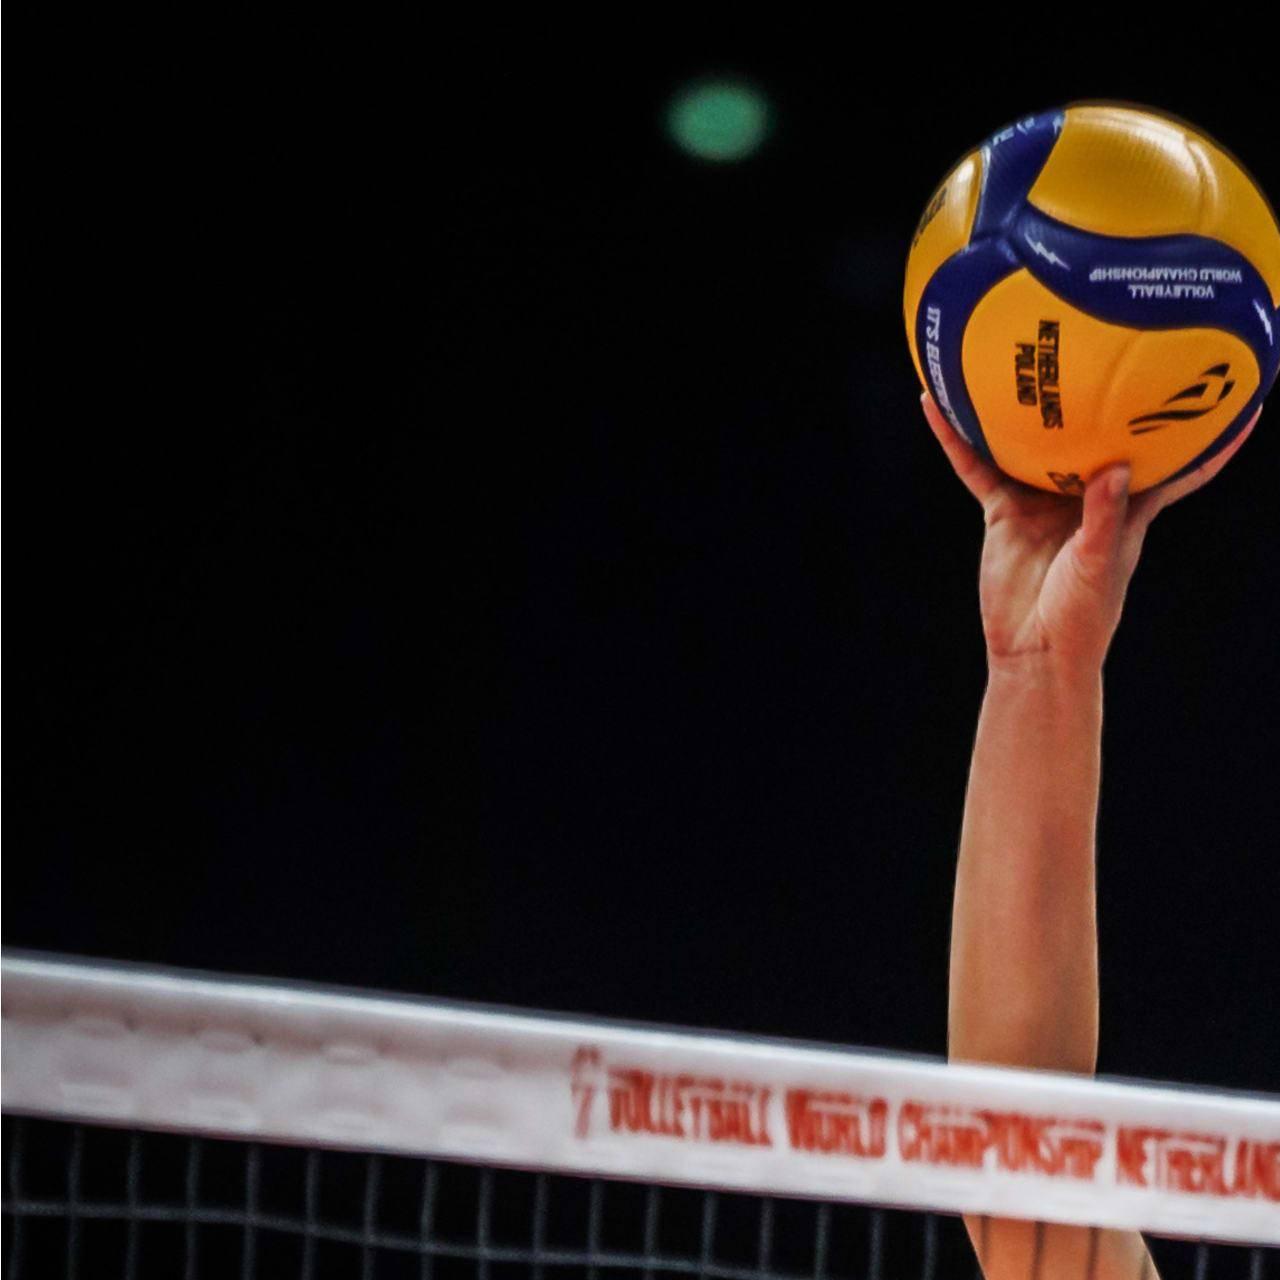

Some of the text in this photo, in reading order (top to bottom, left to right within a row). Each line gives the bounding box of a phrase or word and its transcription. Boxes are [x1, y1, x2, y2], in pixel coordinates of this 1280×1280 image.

[1089, 265, 1243, 283] WORLD CHAMPIONSHIP
[1128, 284, 1214, 299] VOLLEYBALL
[608, 1066, 773, 1148] VOLLEYBALL
[785, 1086, 889, 1159] WORLD
